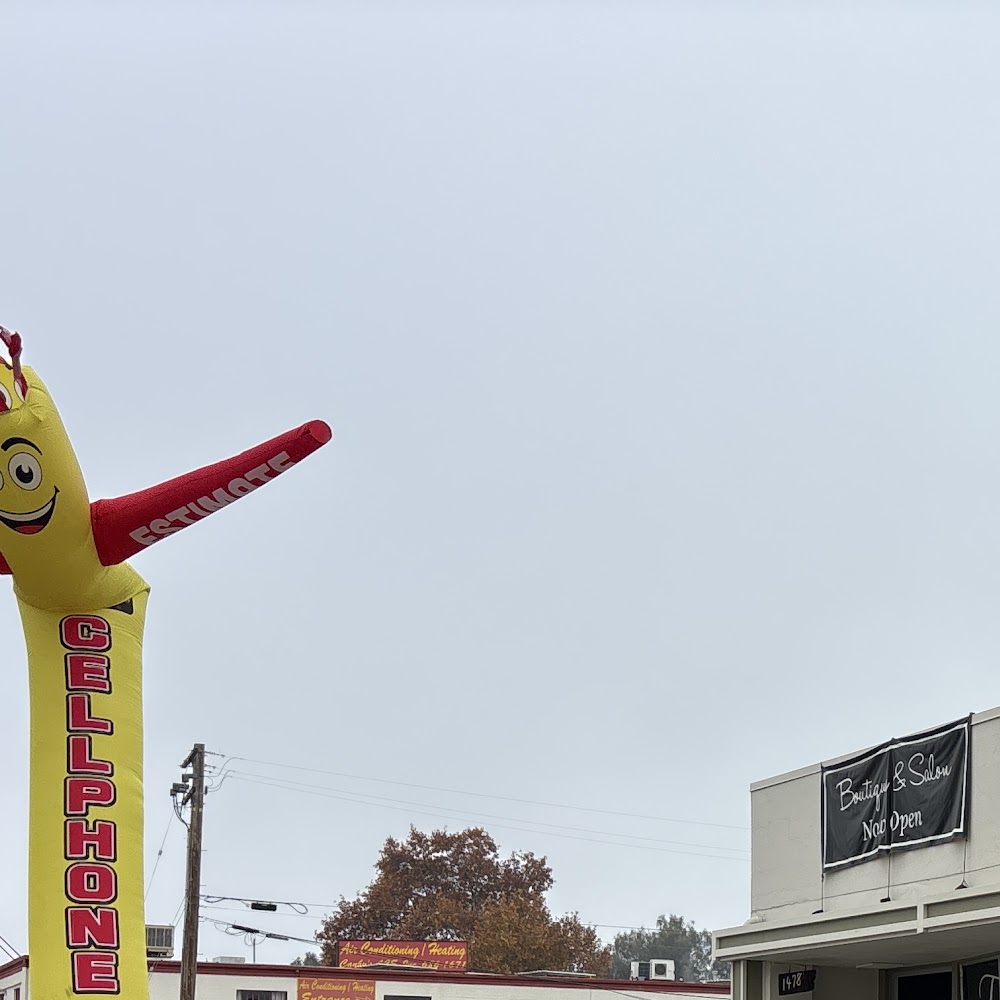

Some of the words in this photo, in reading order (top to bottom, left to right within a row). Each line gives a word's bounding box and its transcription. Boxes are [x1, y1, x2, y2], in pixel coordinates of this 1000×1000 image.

[129, 451, 296, 546] ESTIMATE
[893, 761, 906, 791] &
[908, 752, 952, 786] Salon
[59, 613, 121, 995] CELLPHONE
[890, 810, 922, 837] Open
[340, 942, 358, 955] Air
[360, 941, 420, 959] Conditioning
[427, 942, 466, 960] Heating
[299, 980, 310, 990] Air
[311, 979, 347, 993] Conditioning
[352, 981, 374, 994] Heating
[782, 972, 803, 991] 1478
